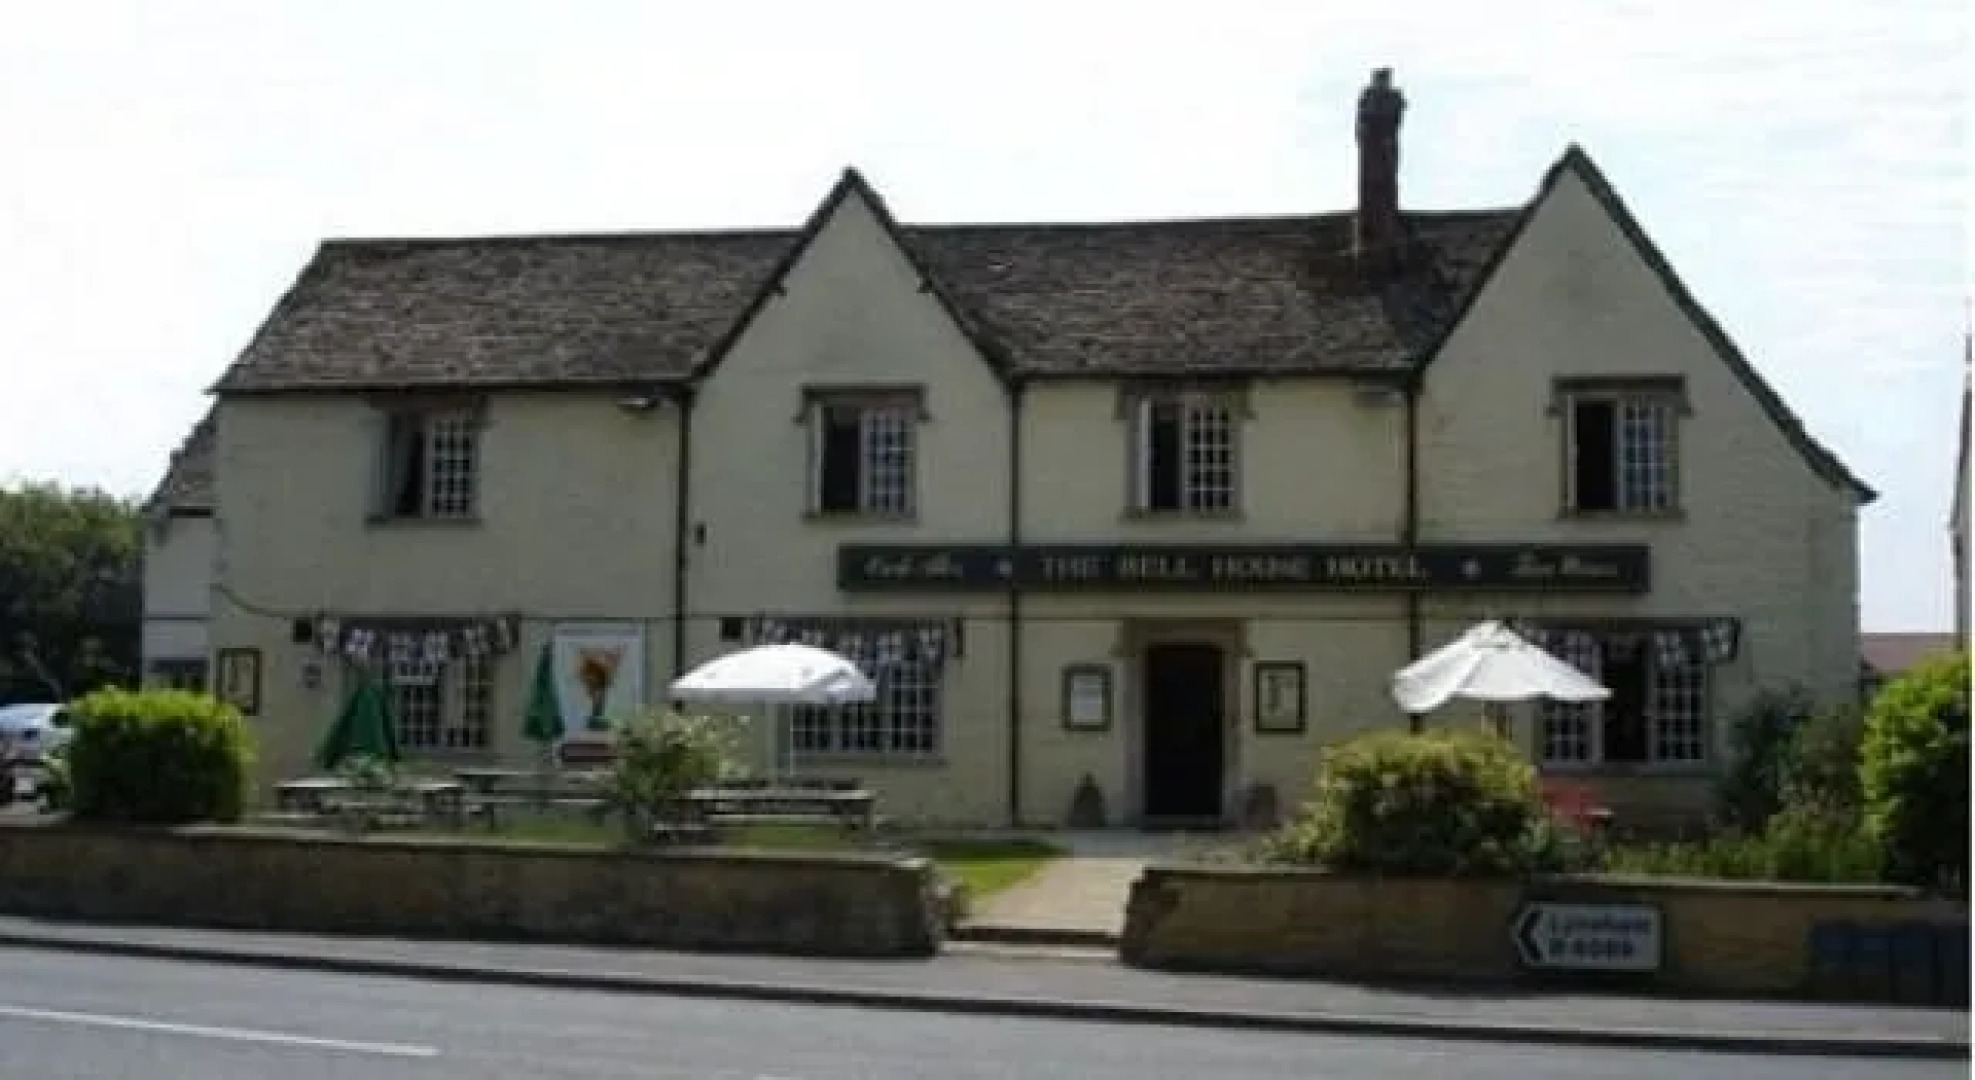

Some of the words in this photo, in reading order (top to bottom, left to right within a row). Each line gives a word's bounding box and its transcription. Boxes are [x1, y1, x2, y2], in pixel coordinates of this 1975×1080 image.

[1040, 554, 1101, 580] THE
[1116, 554, 1198, 580] BELL
[1211, 554, 1311, 580] HOUSE
[1324, 554, 1430, 581] HOTEL
